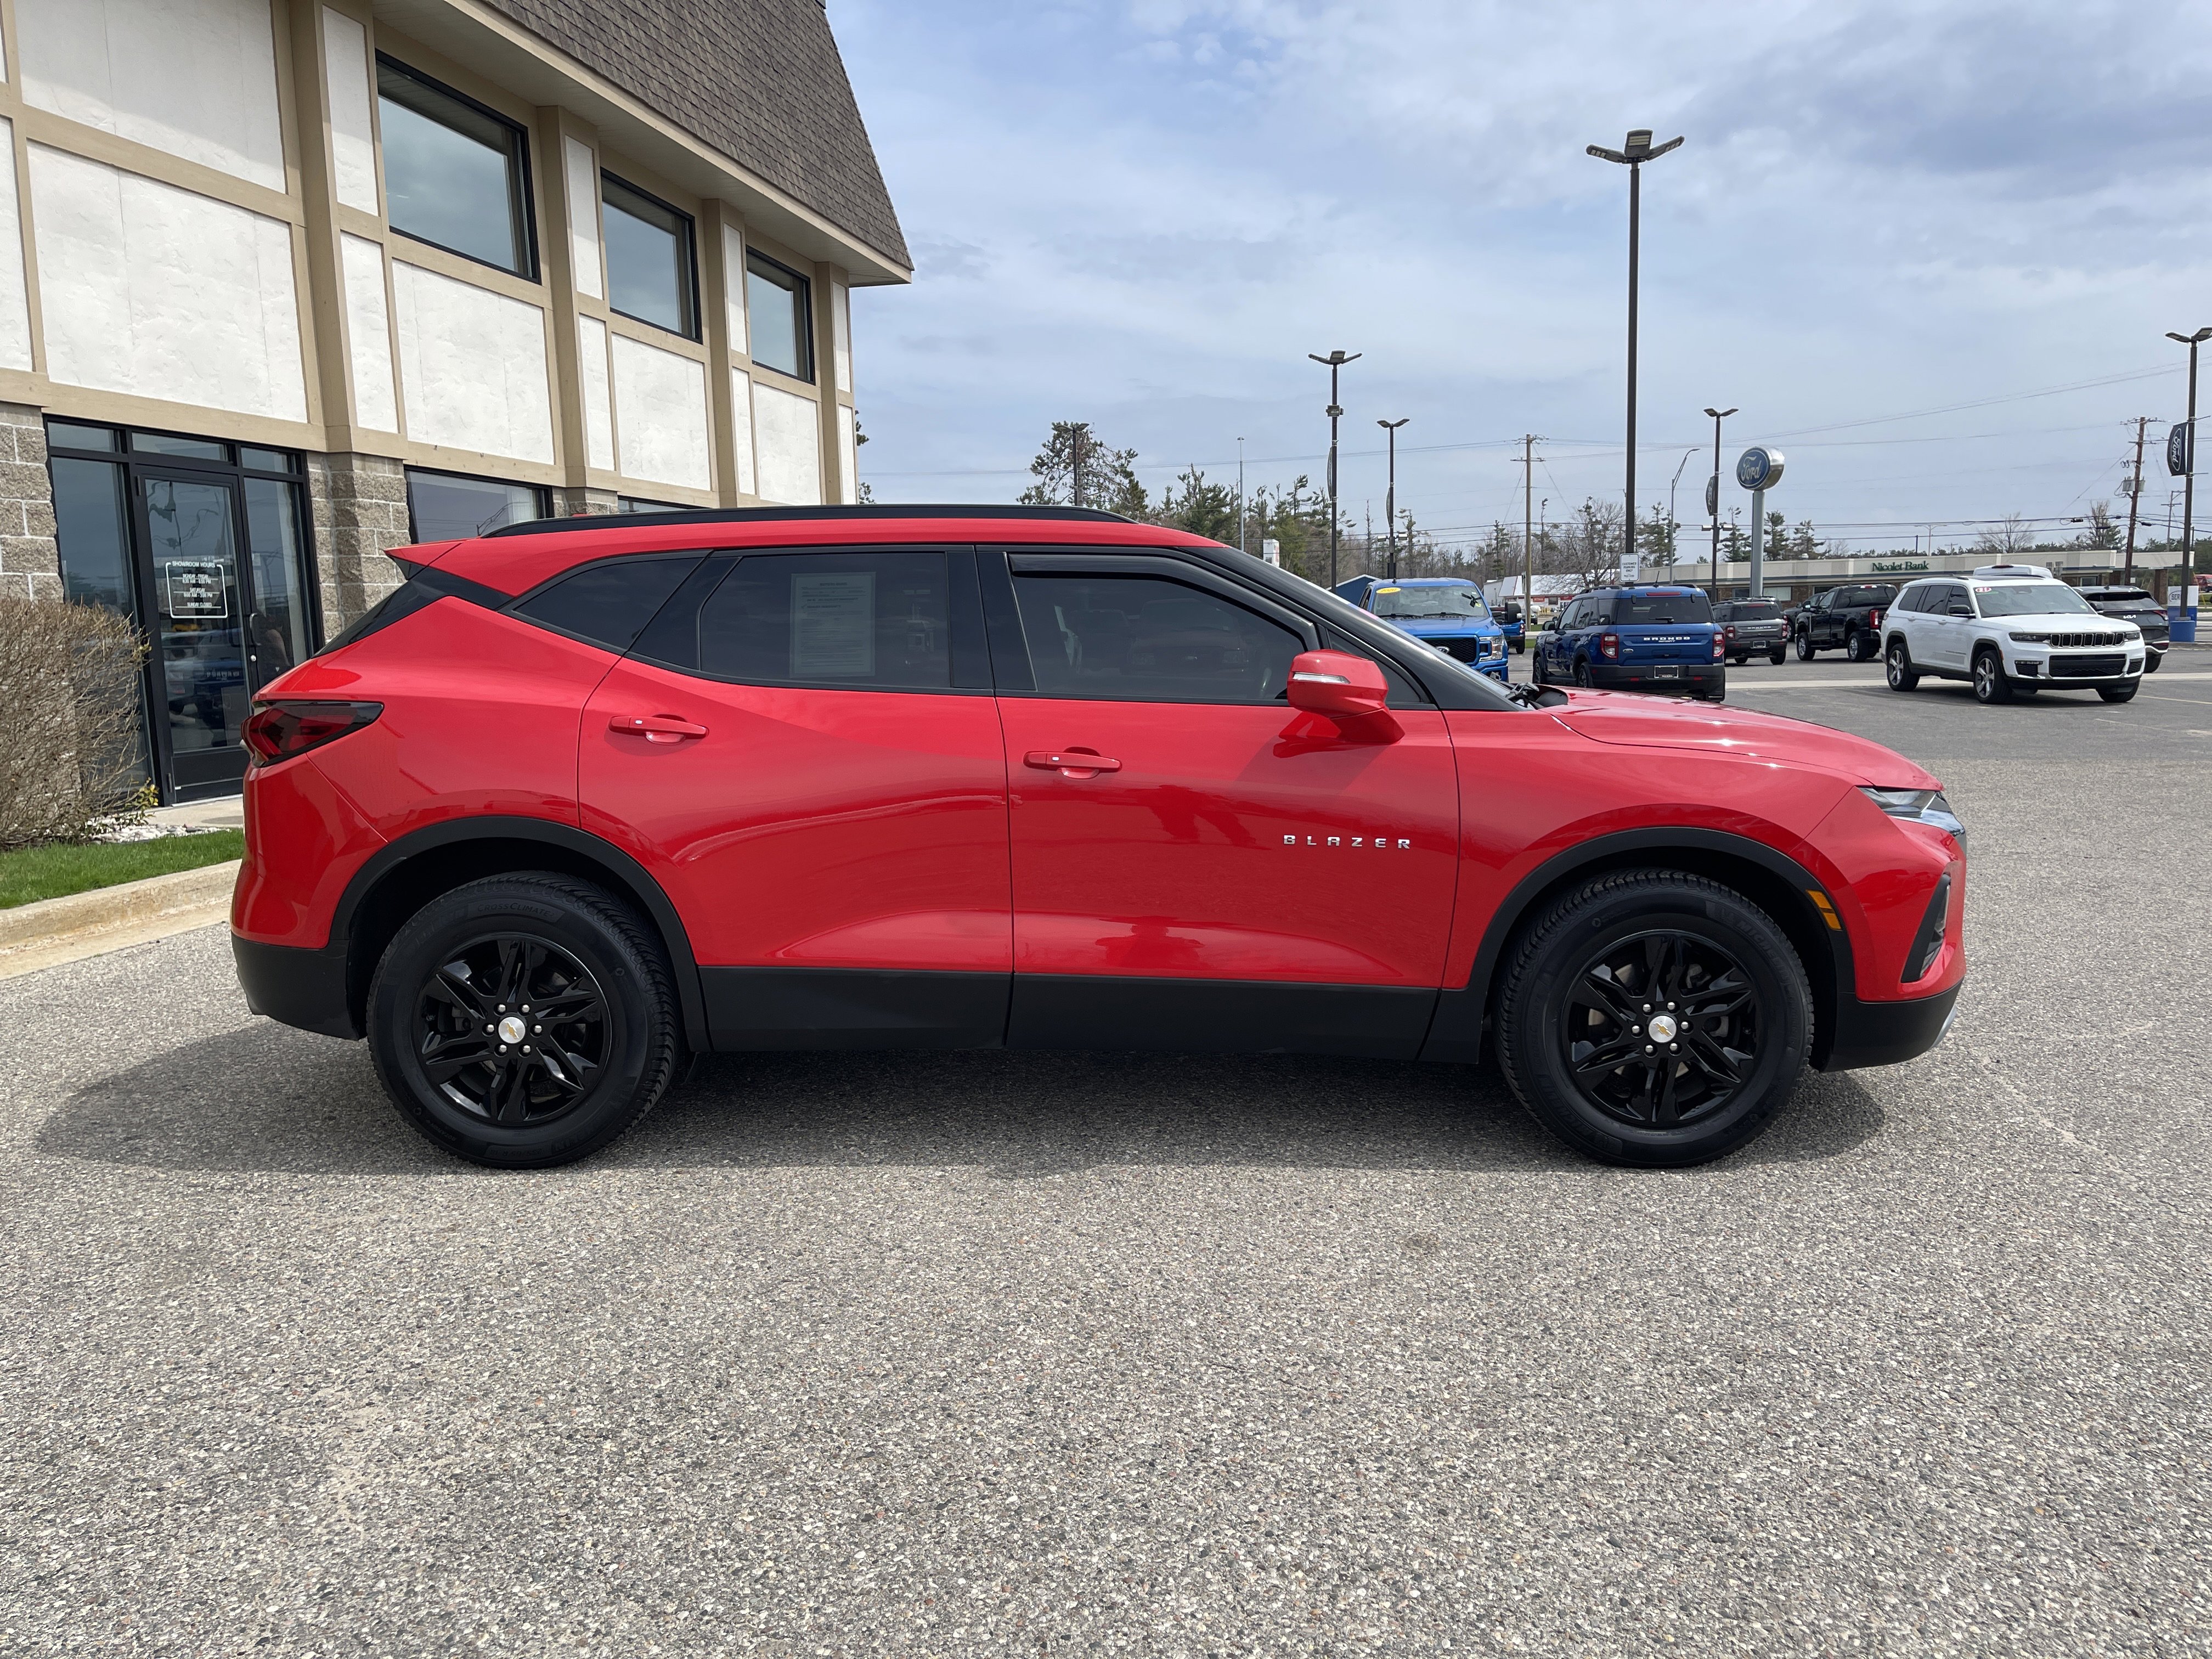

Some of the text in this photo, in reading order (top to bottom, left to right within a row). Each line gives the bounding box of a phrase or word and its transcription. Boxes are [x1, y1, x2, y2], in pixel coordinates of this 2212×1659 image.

[2172, 436, 2181, 463] Ford
[1741, 456, 1762, 481] Ford
[1871, 561, 1929, 572] Nicolet Bank
[1284, 834, 1410, 849] BLAZER
